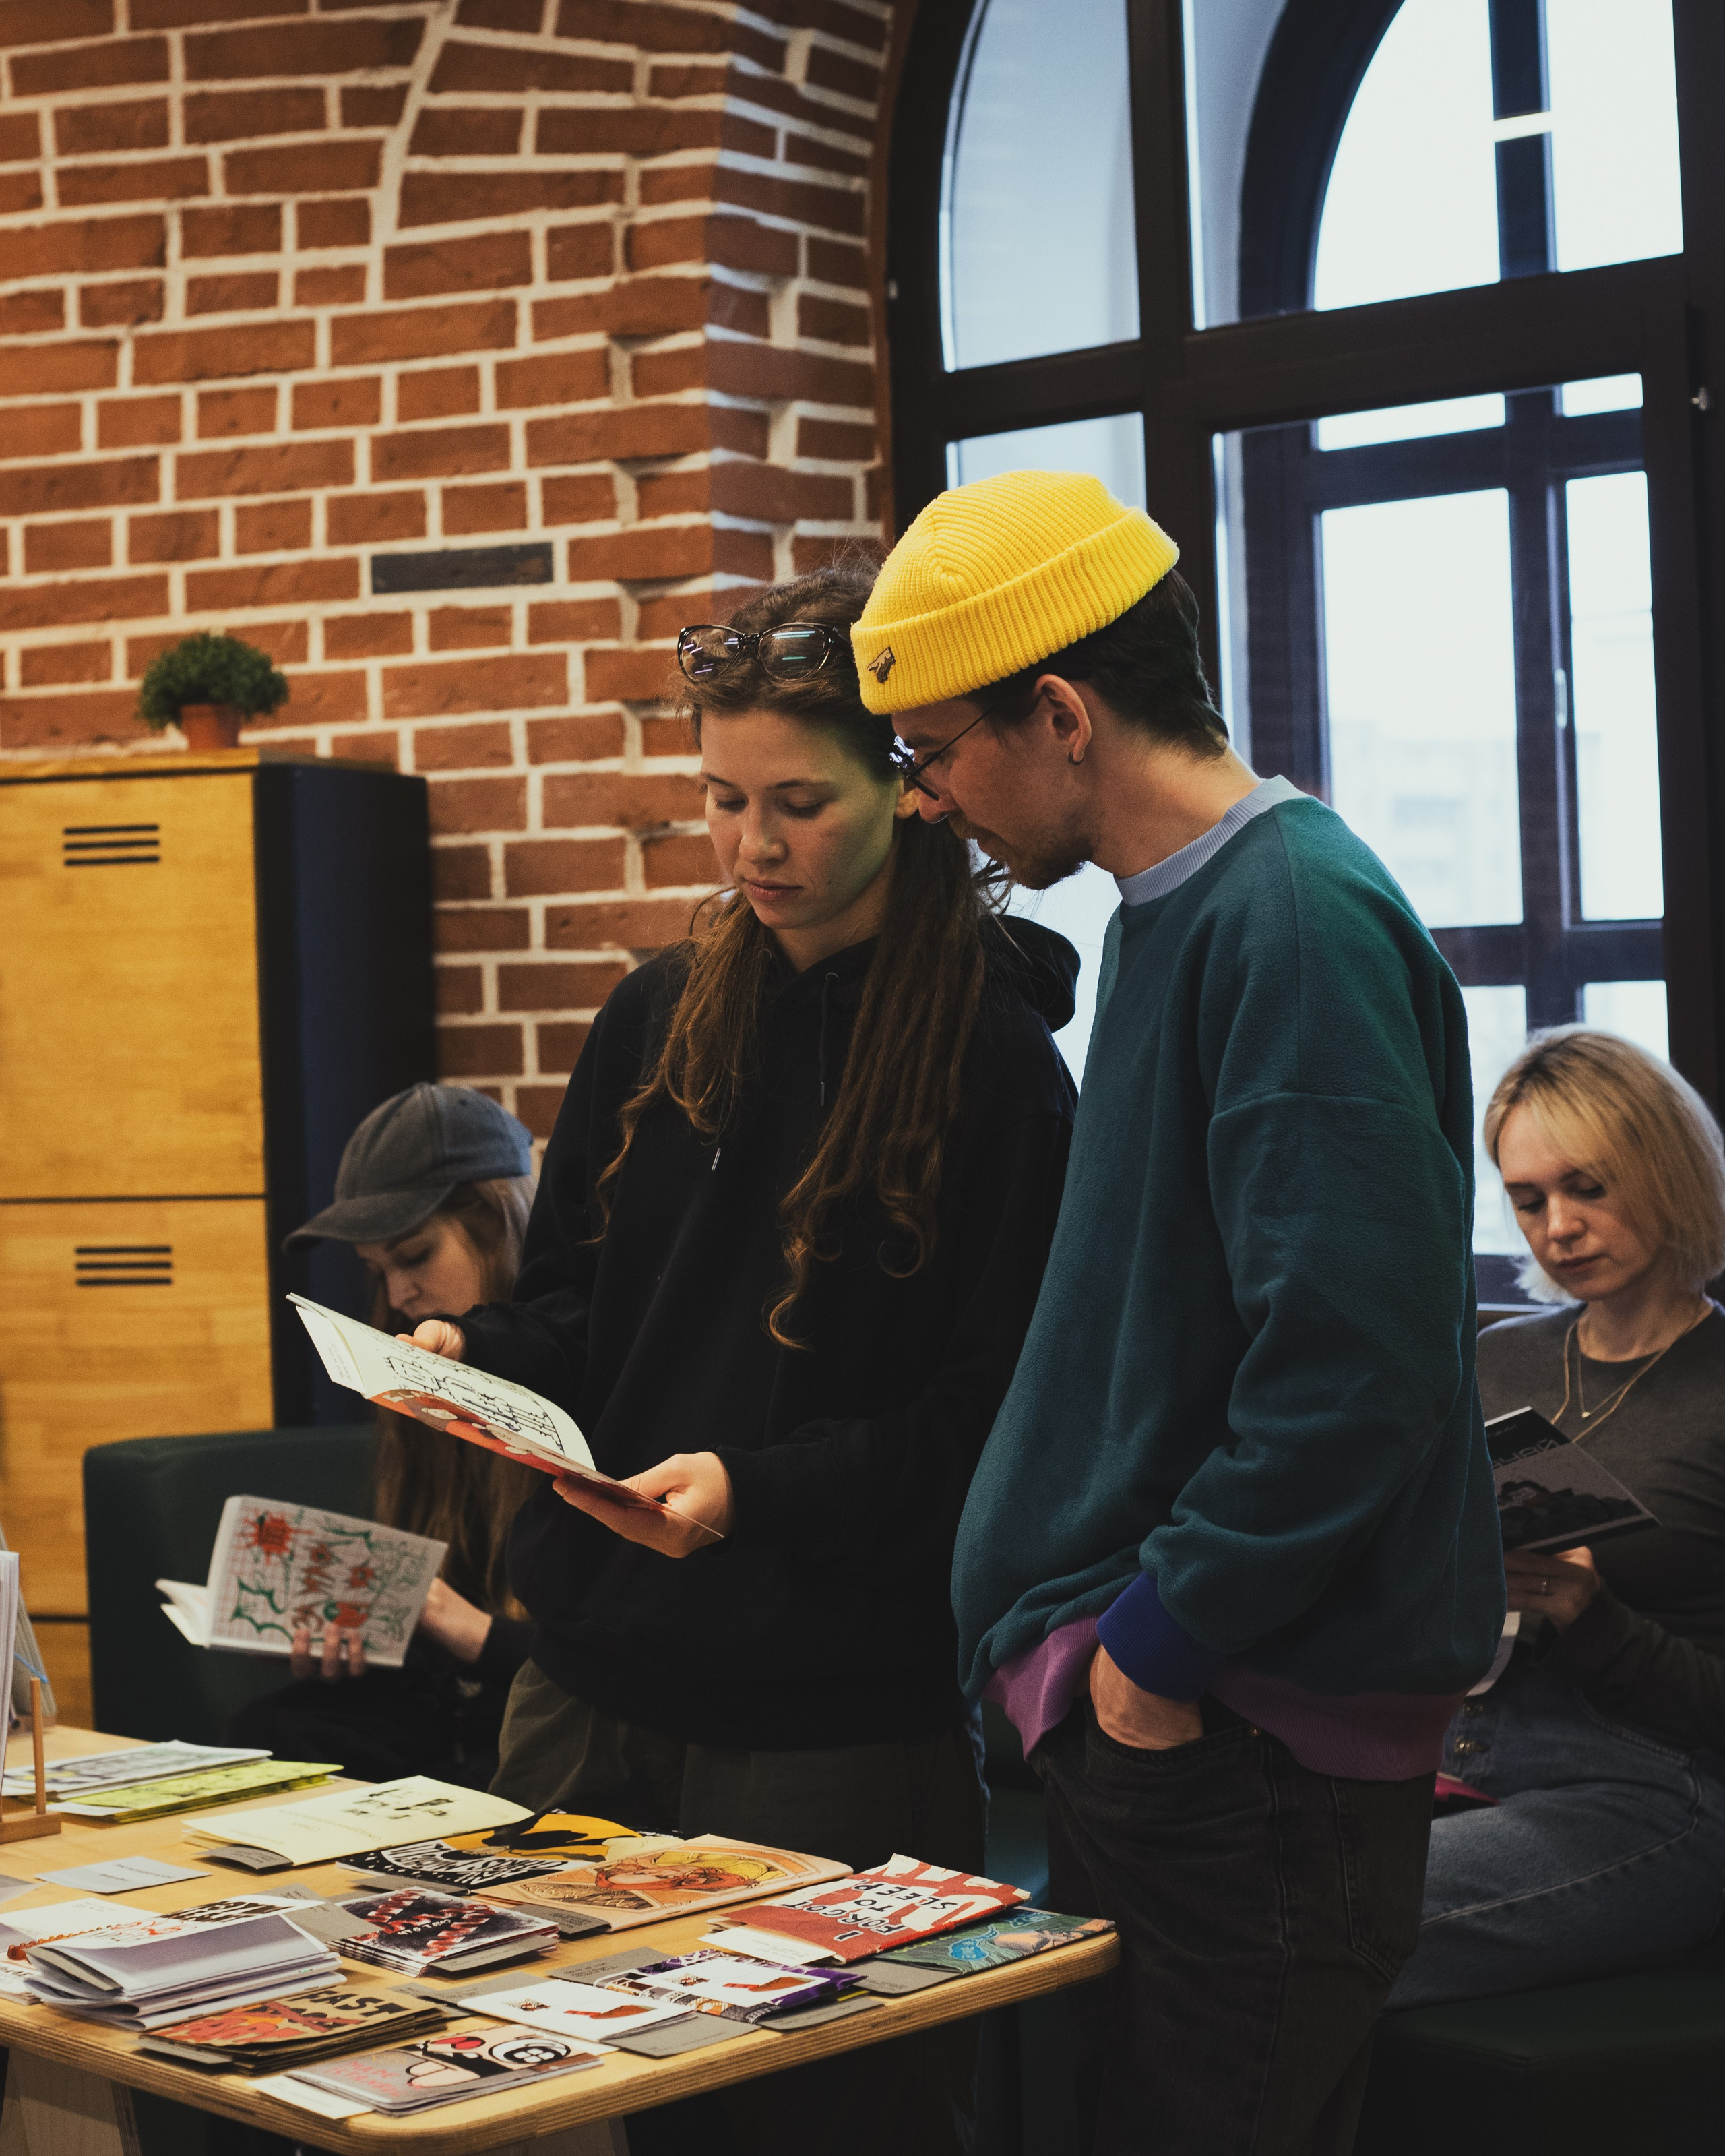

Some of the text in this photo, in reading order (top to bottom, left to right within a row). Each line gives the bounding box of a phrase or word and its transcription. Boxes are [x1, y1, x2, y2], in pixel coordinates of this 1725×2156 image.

[854, 1899, 893, 1912] TO
[780, 1901, 906, 1934] FORGOT
[835, 1930, 862, 1940] I
[288, 1990, 412, 2018] FAST
